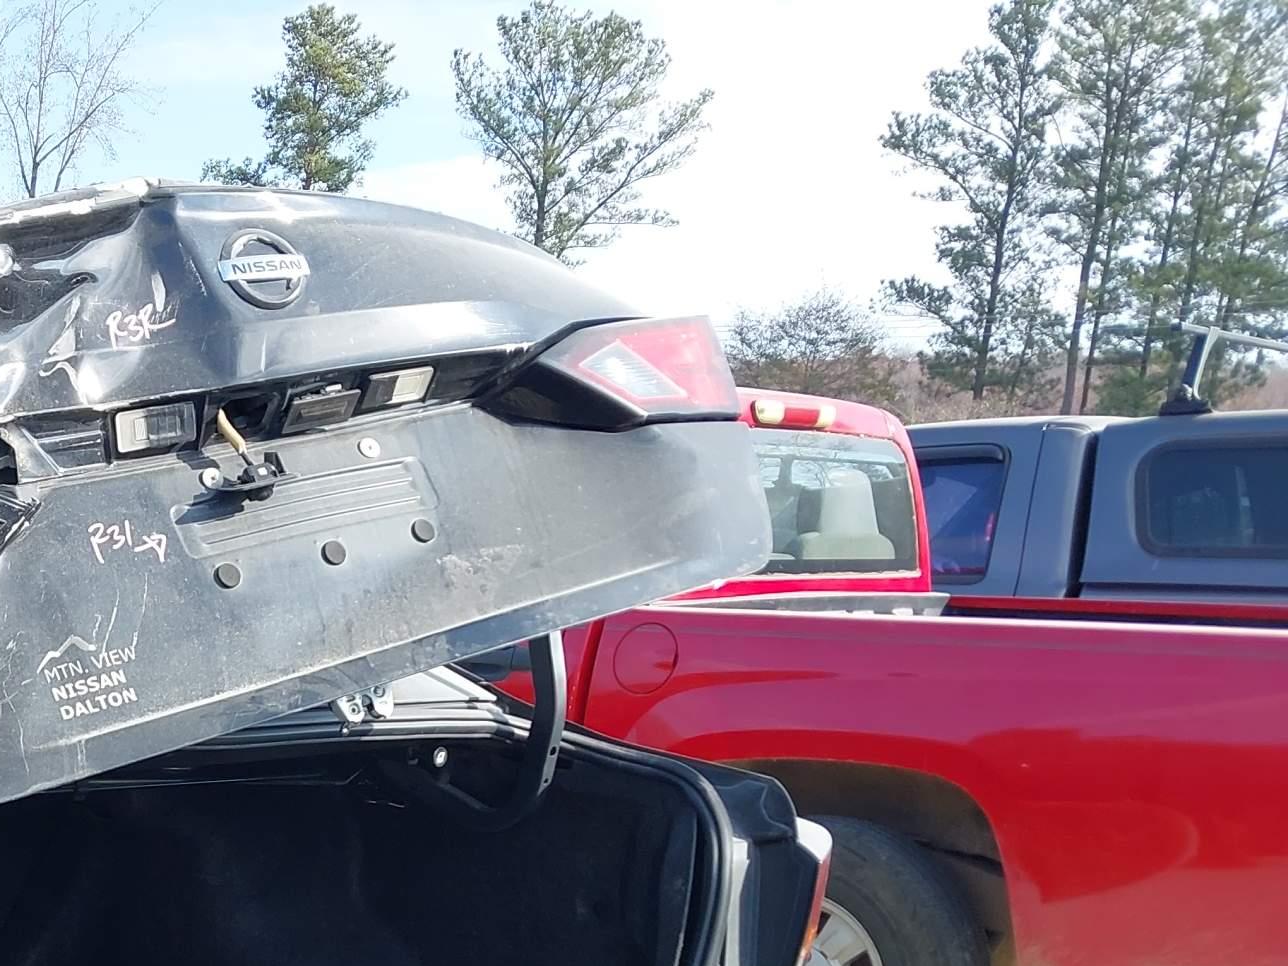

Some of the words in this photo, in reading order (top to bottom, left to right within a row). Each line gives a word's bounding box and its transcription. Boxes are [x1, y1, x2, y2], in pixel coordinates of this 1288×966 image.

[231, 259, 302, 275] NISSAN
[44, 660, 89, 684] MTN.
[90, 645, 136, 669] VIEW
[52, 669, 127, 702] NISSAN
[60, 687, 138, 720] DALTON
